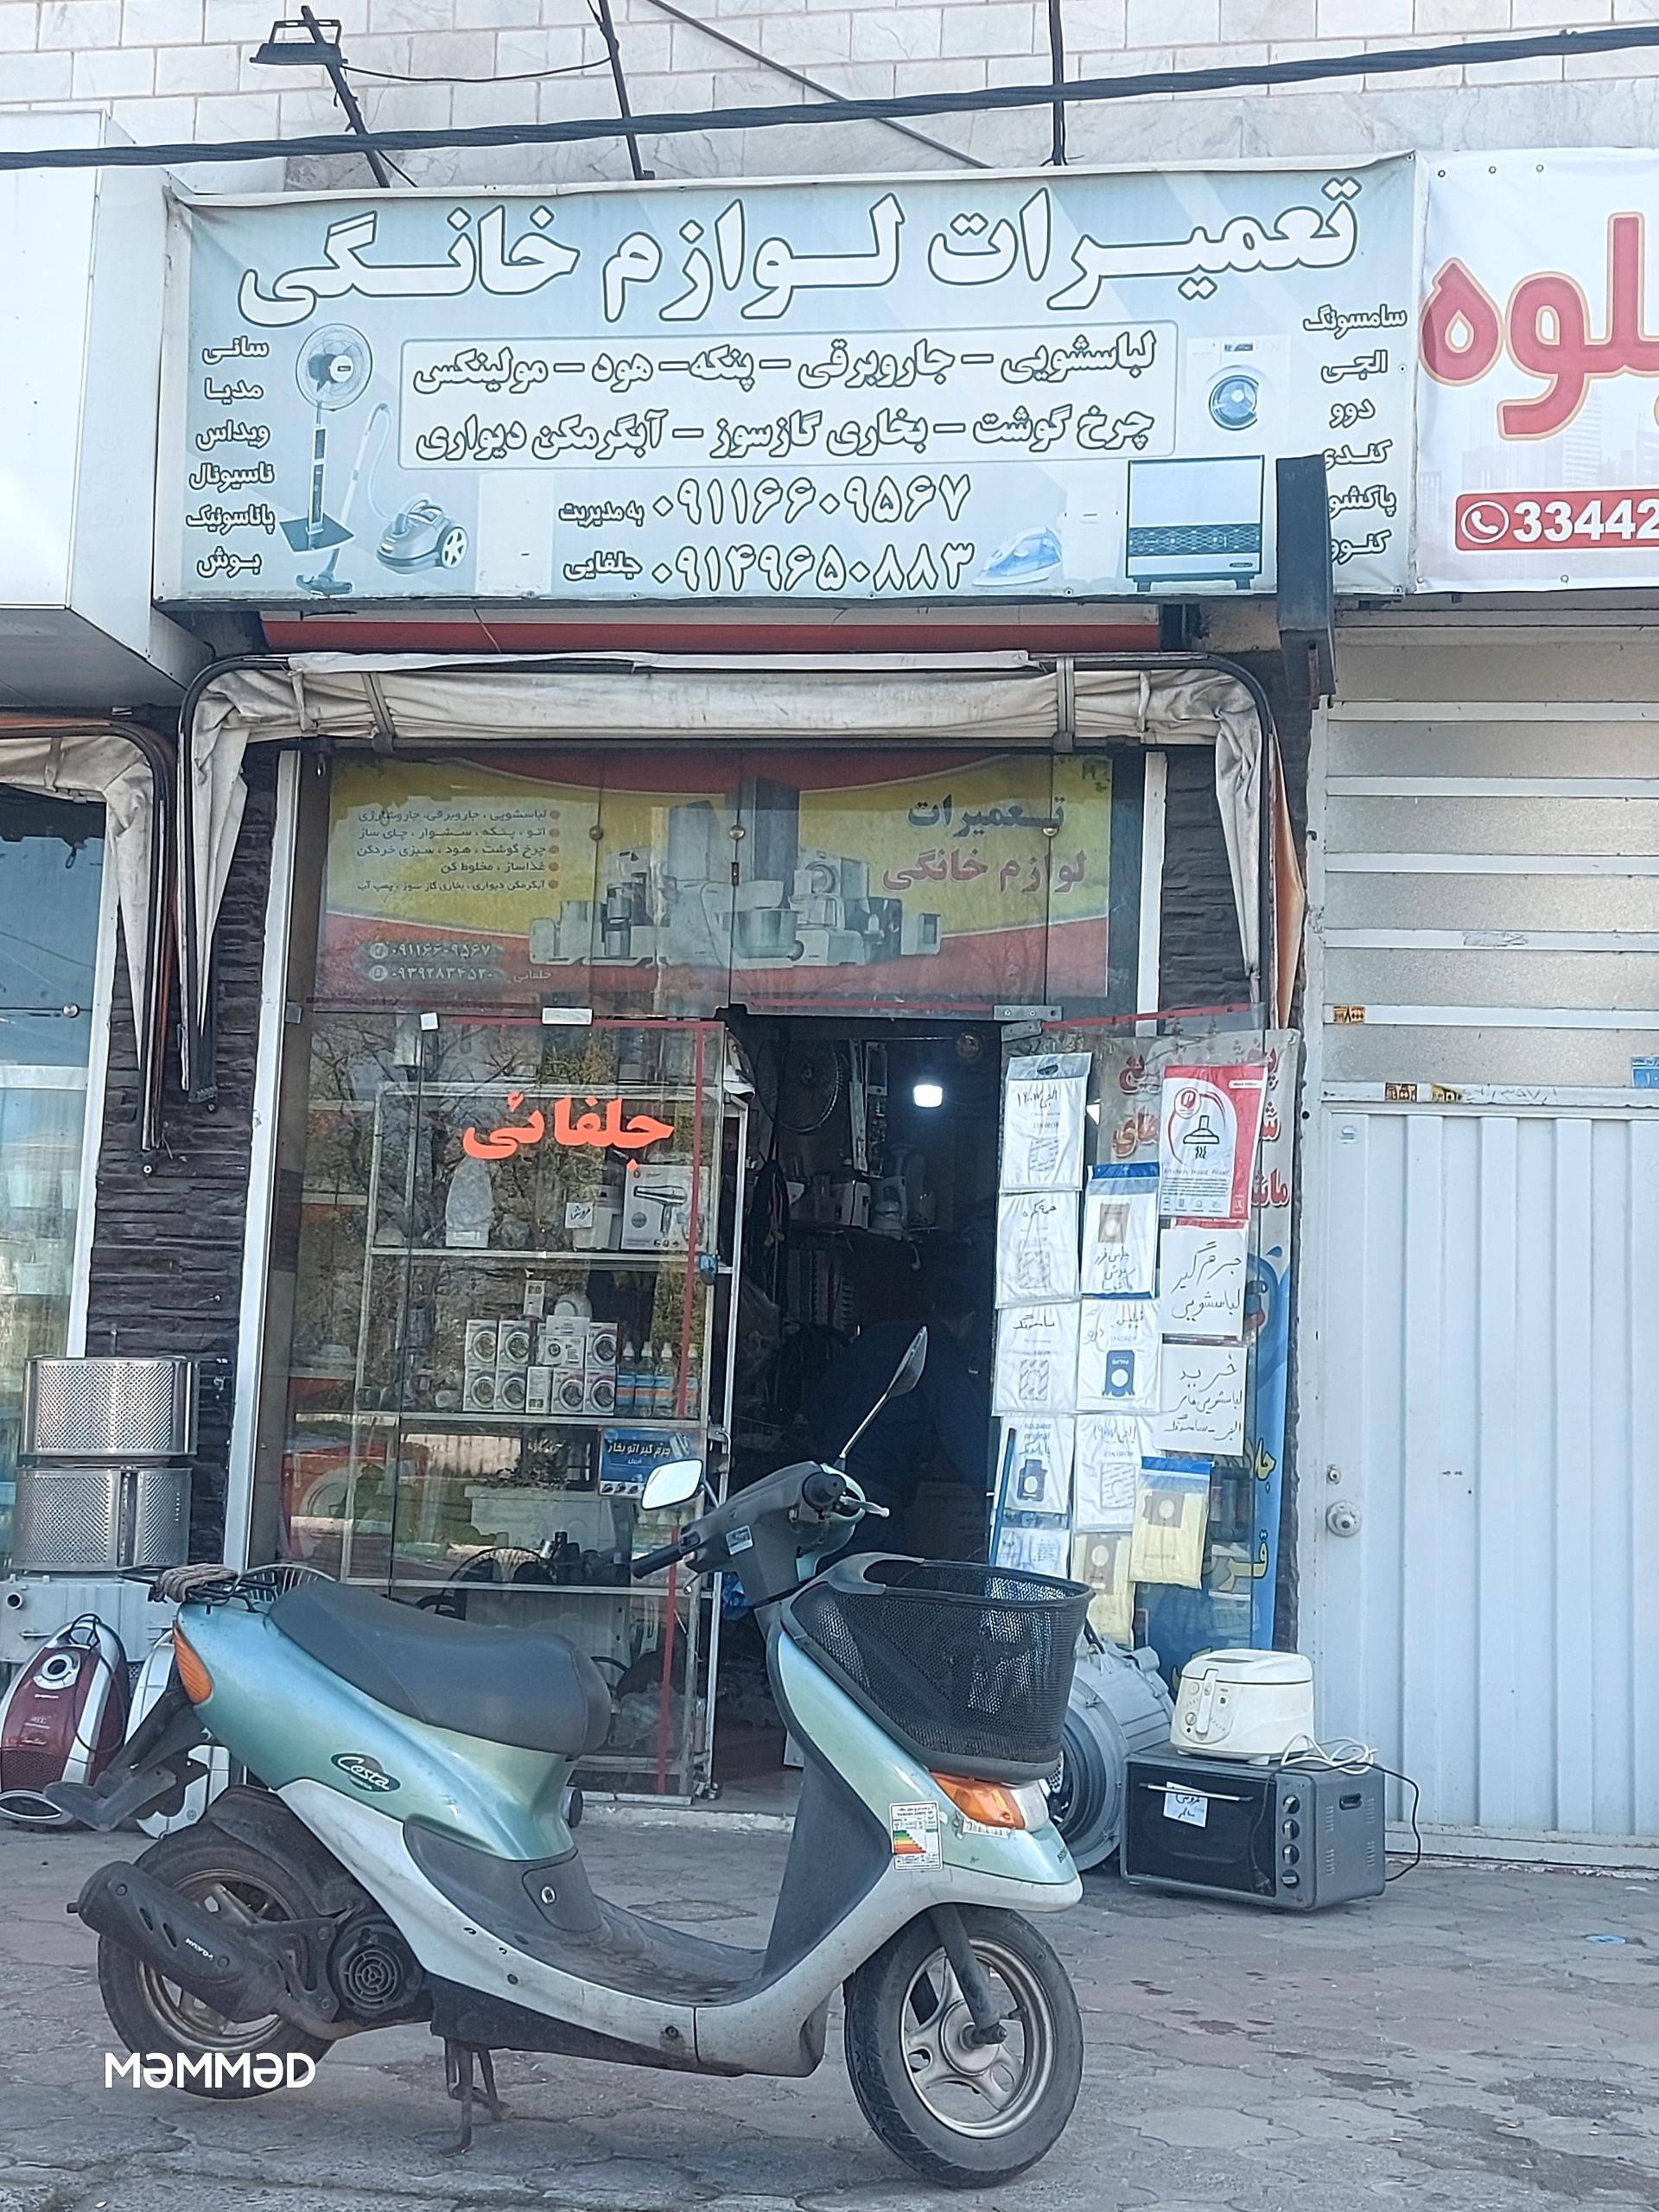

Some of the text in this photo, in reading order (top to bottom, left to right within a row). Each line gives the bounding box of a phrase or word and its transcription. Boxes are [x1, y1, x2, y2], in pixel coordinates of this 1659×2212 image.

[238, 177, 1362, 327] تعمیرات لوازم خانگی
[1302, 303, 1408, 340] سامسونگ
[1419, 212, 1659, 442] لوه
[201, 334, 270, 365] سانی
[690, 344, 754, 391] پنکه
[798, 338, 956, 389] جاروبرقی
[1001, 330, 1156, 384] لباسشویی
[1320, 349, 1389, 384] الجی
[414, 346, 548, 394] مولینکس
[592, 353, 653, 392] هود
[204, 377, 264, 405] مدیا
[826, 408, 928, 456] بخاری
[973, 404, 1072, 452] گوشت
[1077, 404, 1154, 450] چرخ
[1328, 397, 1376, 429] دوو
[195, 419, 270, 451] ویداس
[416, 414, 527, 460] دیواری
[1322, 438, 1393, 471] کندی
[189, 461, 275, 493] ناسیونال
[652, 474, 971, 524] ۰۹۱۱۶۶۰۹۵۶۷
[185, 503, 276, 536] پاناسونیک
[196, 545, 262, 578] بوش
[563, 543, 975, 592] ۰۹۱۴۹۶۵۰۸۸۳ جلفایی
[418, 828, 472, 841] سشوار
[482, 827, 515, 840] پنکه
[490, 809, 547, 822] لباسشویی
[907, 793, 1065, 837] تعمیرات
[445, 846, 472, 855] هود
[882, 846, 1088, 893] لوازم خانگی
